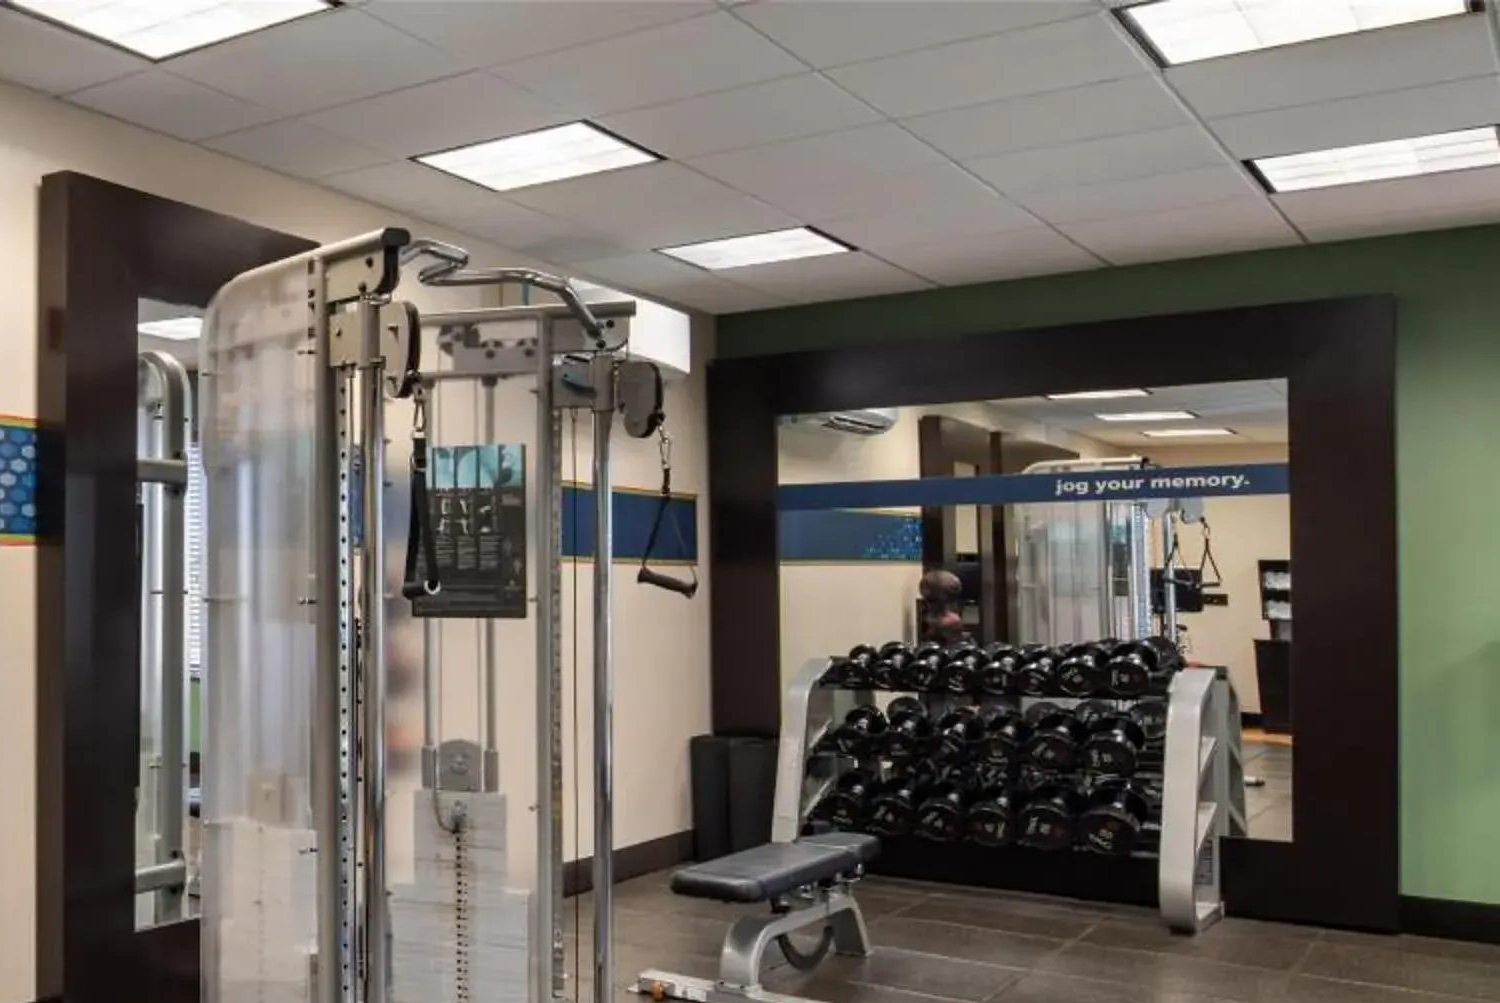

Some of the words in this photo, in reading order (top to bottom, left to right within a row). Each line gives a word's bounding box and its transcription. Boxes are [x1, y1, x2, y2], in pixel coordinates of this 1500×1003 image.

[1055, 479, 1089, 496] jog
[1095, 478, 1145, 495] your
[1150, 474, 1251, 489] memory.
